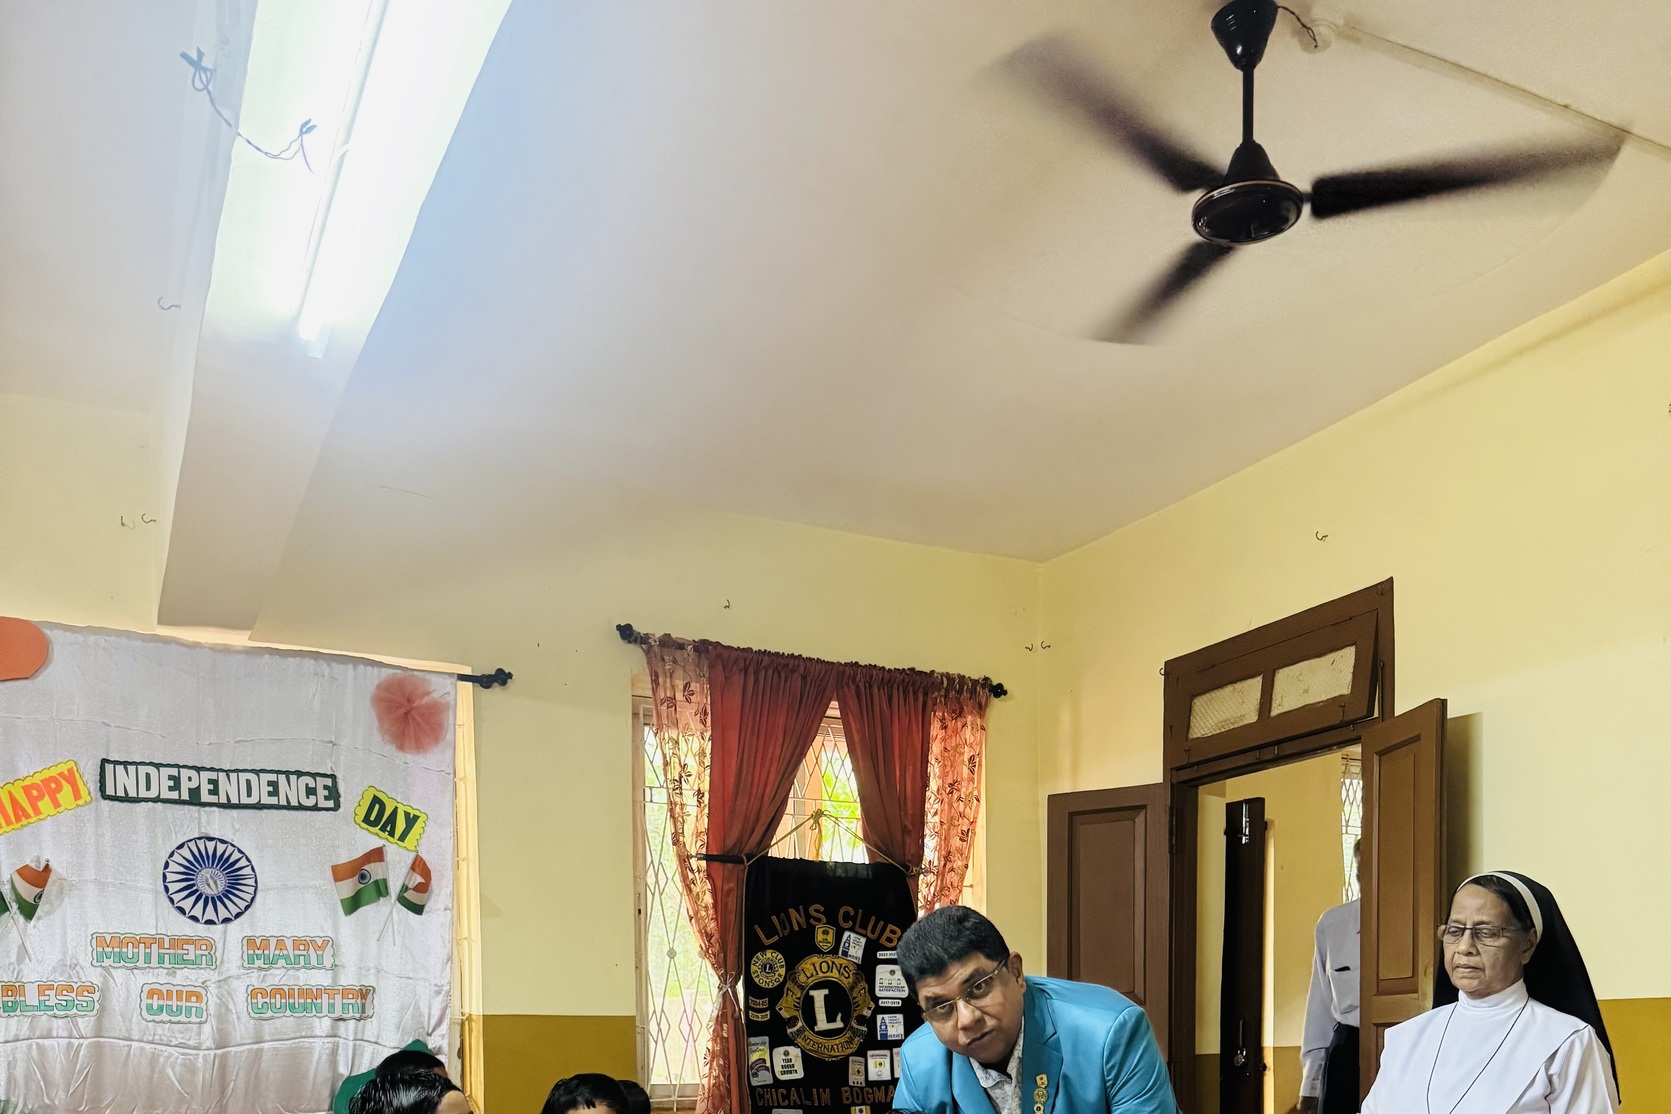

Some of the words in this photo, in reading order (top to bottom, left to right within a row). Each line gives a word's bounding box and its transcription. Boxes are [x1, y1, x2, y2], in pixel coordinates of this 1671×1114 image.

[104, 762, 335, 809] INDEPENDENCE
[360, 794, 421, 842] DAY
[753, 904, 827, 946] LIONS
[838, 905, 902, 949] CLUB
[95, 935, 214, 968] MOTHER
[245, 937, 331, 968] MARY
[752, 949, 767, 967] NEW
[770, 951, 785, 969] CLUB
[752, 970, 784, 987] SPONSOR
[802, 960, 852, 980] LIONS
[1, 982, 96, 1014] BLESS
[145, 986, 205, 1019] OUR
[249, 985, 373, 1018] COUNTRY
[809, 988, 845, 1032] L
[755, 1087, 831, 1107] CHICALIM
